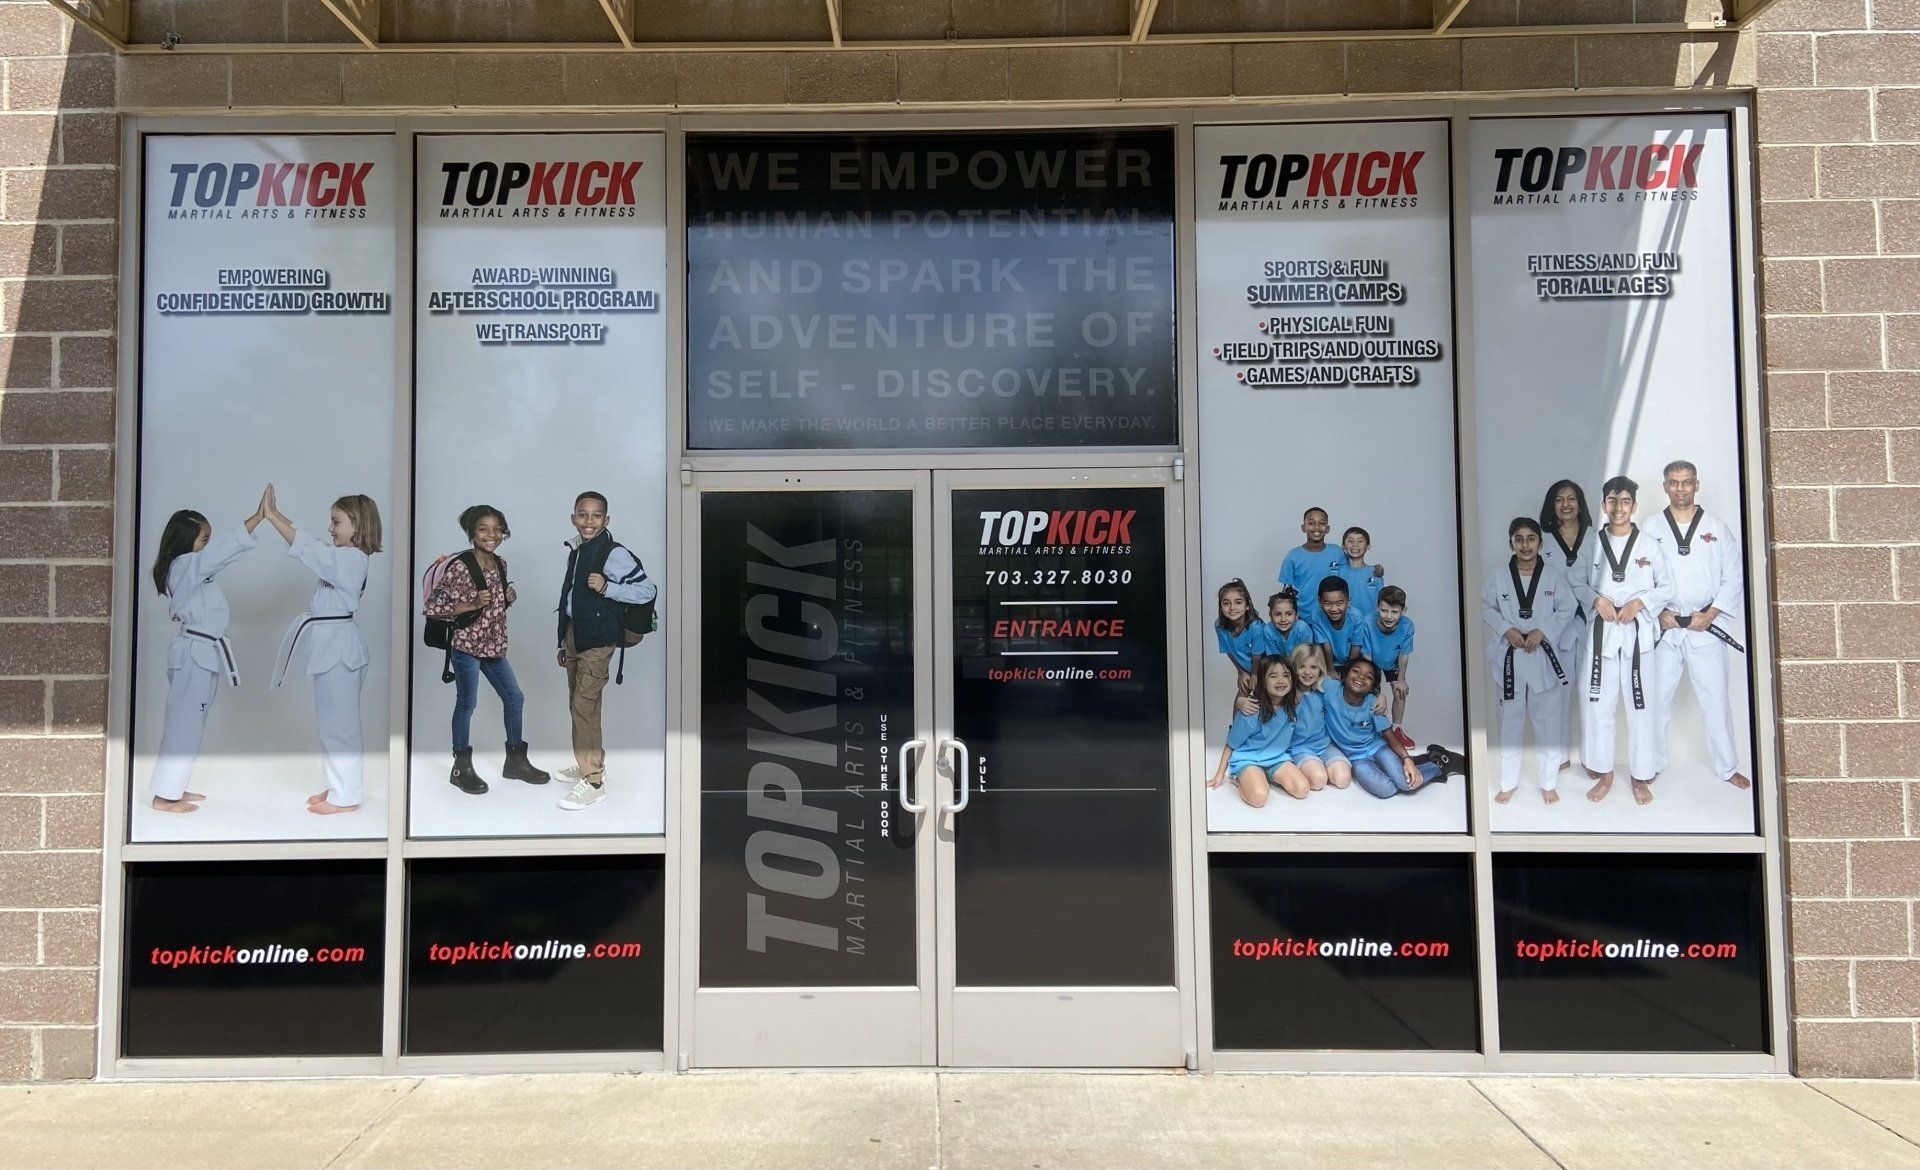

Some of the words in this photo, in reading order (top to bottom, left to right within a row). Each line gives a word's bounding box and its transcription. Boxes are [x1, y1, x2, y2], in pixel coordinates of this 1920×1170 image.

[707, 152, 799, 190] WE
[830, 149, 1152, 190] EMPOWER
[1220, 151, 1425, 199] TOPKICK
[1494, 144, 1705, 193] TOPKICK
[170, 162, 374, 207] TOPKICK
[442, 161, 643, 207] TOPKICK
[1218, 200, 1283, 211] MARTIAL
[1292, 199, 1329, 210] ARTS
[1338, 199, 1346, 209] &
[1355, 198, 1418, 209] FITNESS
[1493, 194, 1559, 205] MARTIAL
[1569, 192, 1608, 203] ARTS
[1616, 192, 1624, 202] &
[1634, 191, 1698, 201] FITNESS
[168, 209, 232, 220] MARTIAL
[241, 209, 278, 219] ARTS
[288, 209, 295, 219] &
[305, 208, 367, 219] FITNESS
[440, 208, 503, 218] MARTIAL
[513, 208, 548, 218] ARTS
[558, 208, 565, 218] &
[575, 207, 636, 217] FITNESS
[706, 210, 872, 239] HUMAN
[893, 208, 1153, 239] POTENTIAL
[1264, 260, 1328, 277] SPORTS
[1333, 260, 1347, 276] &
[1351, 260, 1382, 275] FUN
[1528, 254, 1597, 271] FITNESS
[1601, 253, 1636, 270] AND
[1643, 253, 1675, 268] FUN
[218, 268, 324, 285] EMPOWERING
[472, 267, 610, 284] AWARD-WINNING
[709, 260, 823, 294] AND
[841, 258, 1024, 294] SPARK
[1048, 257, 1154, 292] THE
[1247, 283, 1328, 302] SUMMER
[1335, 282, 1401, 301] CAMPS
[1536, 278, 1574, 295] FOR
[1578, 277, 1613, 294] ALL
[1618, 276, 1668, 293] AGES
[157, 293, 265, 310] CONFIDENCE
[269, 292, 307, 309] AND
[312, 292, 384, 309] GROWTH
[428, 291, 558, 309] AFTERSCHOOL
[564, 291, 653, 308] PROGRAM
[476, 324, 501, 339] WE
[505, 323, 601, 339] TRANSPORT
[708, 313, 1055, 349] ADVENTURE
[1082, 311, 1153, 347] OF
[1270, 317, 1352, 333] PHYSICAL
[1356, 316, 1387, 331] FUN
[1223, 343, 1268, 359] FIELD
[1273, 342, 1320, 358] TRIPS
[1325, 341, 1362, 357] AND
[1364, 340, 1437, 357] OUTINGS
[707, 369, 820, 400] SELF
[877, 367, 1155, 398] DISCOVERY.
[1247, 367, 1305, 383] GAMES
[1309, 366, 1344, 382] AND
[1350, 365, 1414, 382] CRAFTS
[708, 418, 734, 432] WE
[742, 418, 790, 431] MAKE
[797, 418, 831, 431] THE
[836, 418, 900, 431] WORLD
[907, 418, 918, 430] A
[925, 417, 990, 430] BETTER
[999, 417, 1055, 430] PLACE
[1062, 416, 1155, 429] EVERYDAY.
[980, 510, 1136, 546] TOPKICK
[978, 547, 1028, 555] MARTIAL
[1035, 547, 1064, 555] ARTS
[1070, 546, 1076, 555] &
[1084, 545, 1131, 555] FITNESS
[985, 569, 1132, 585] 703.327.8030
[844, 538, 864, 664] FITNESS
[994, 619, 1125, 638] ENTRANCE
[988, 667, 1132, 683] topkickonline.com
[844, 686, 864, 700] &
[745, 520, 840, 953] TOPKICK
[845, 721, 864, 798] ARTS
[880, 746, 888, 791] OTHER
[881, 801, 889, 837] DOOR
[845, 818, 866, 956] MARTIAL
[150, 943, 364, 968] topkickonline.com
[429, 940, 642, 965] topkickonline.com
[1233, 937, 1449, 961] topkickonline.com
[1516, 938, 1738, 961] topkickonline.com
